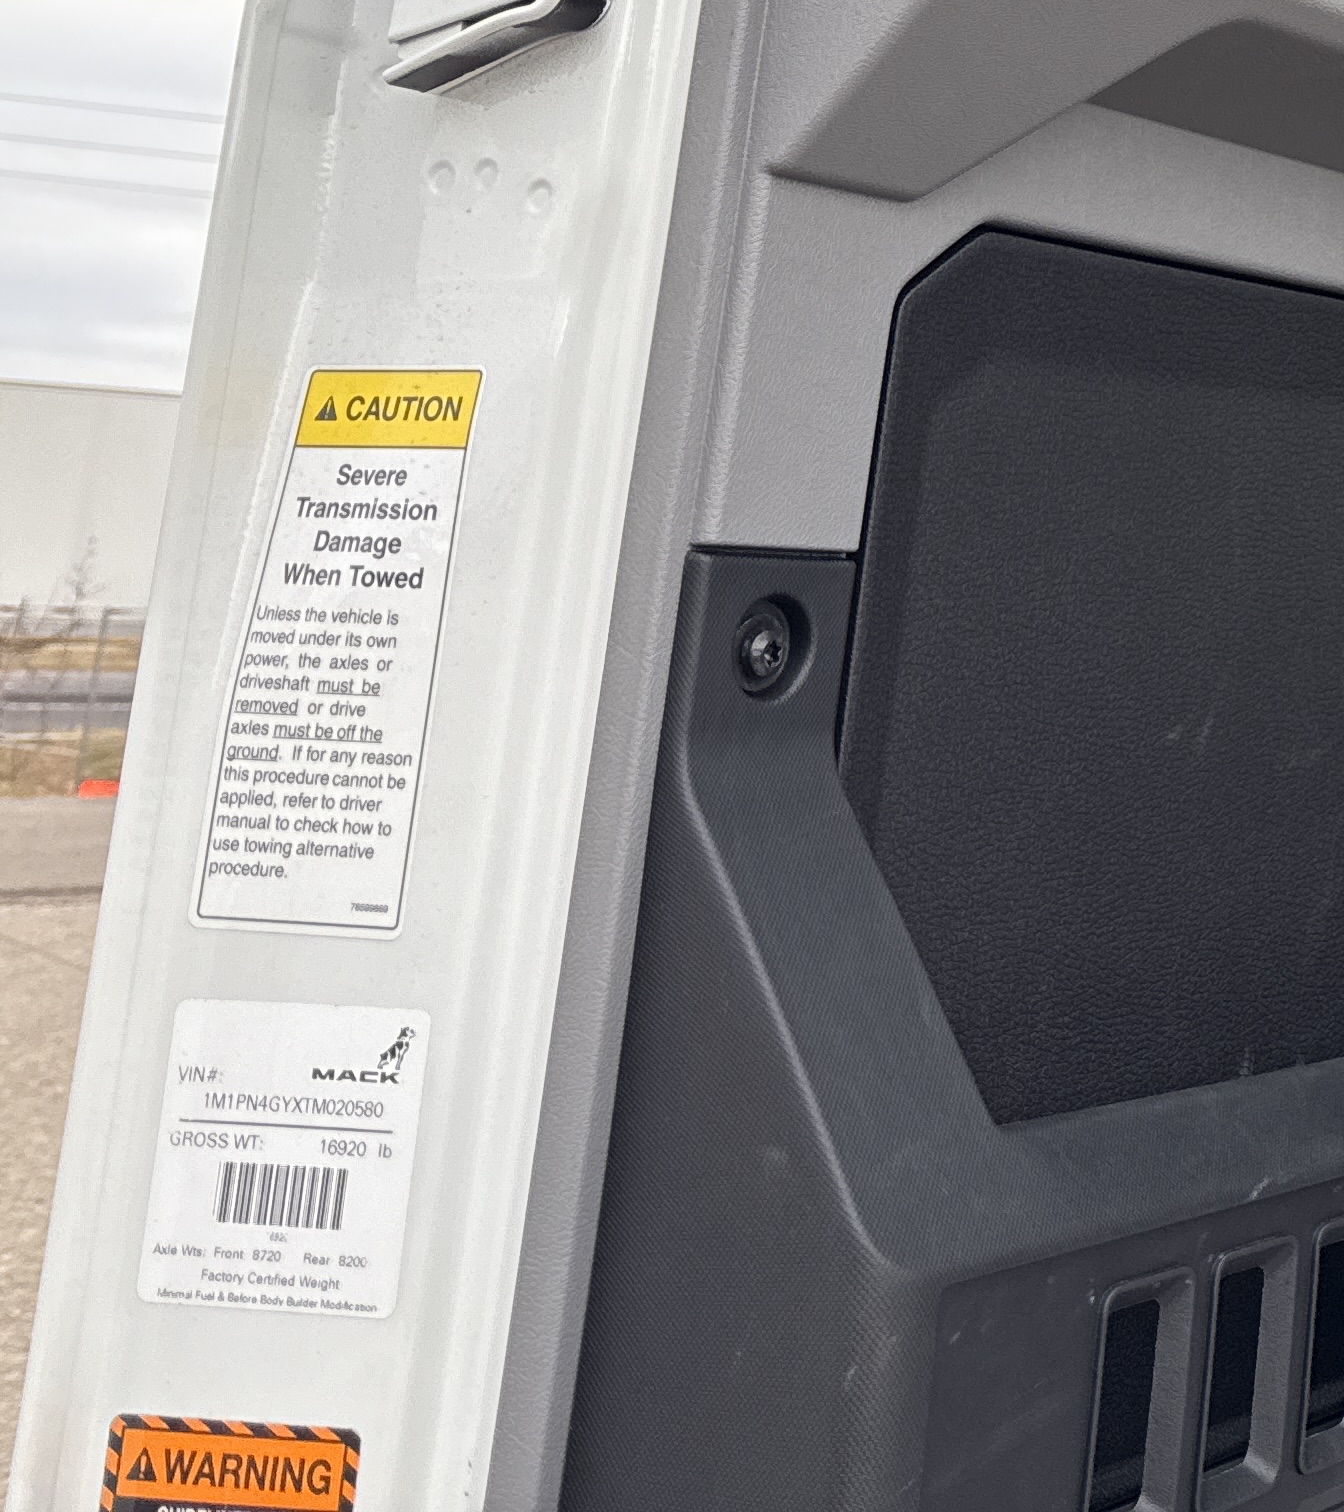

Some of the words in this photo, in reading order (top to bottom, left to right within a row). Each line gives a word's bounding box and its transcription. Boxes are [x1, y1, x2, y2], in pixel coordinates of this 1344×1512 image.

[345, 395, 464, 422] CAUTION
[336, 463, 408, 487] Severe
[296, 496, 438, 521] Transmission
[312, 529, 402, 560] Damage
[284, 562, 342, 586] When
[351, 564, 425, 590] Towed
[256, 606, 302, 623] Unless
[304, 606, 327, 623] the
[331, 607, 383, 625] vehicle
[386, 609, 399, 626] is
[250, 629, 296, 645] moved
[298, 630, 342, 647] under
[344, 631, 363, 649] its
[366, 635, 398, 649] own
[243, 653, 289, 669] power,
[298, 652, 322, 669] the
[328, 654, 369, 671] axles
[376, 659, 394, 673] or
[239, 674, 311, 691] driveshaft
[316, 678, 355, 695] must
[360, 678, 381, 696] be
[234, 698, 300, 716] removed
[307, 702, 324, 715] or
[329, 700, 366, 718] drive
[230, 719, 270, 737] axles
[272, 722, 312, 739] must
[312, 722, 334, 740] be
[336, 724, 358, 741] off
[359, 725, 384, 742] the
[291, 745, 303, 761] If
[306, 745, 327, 762] for
[329, 750, 358, 768] any
[360, 752, 413, 767] reason
[223, 765, 250, 782] this
[252, 768, 330, 787] procedure
[331, 773, 384, 789] cannot
[386, 773, 407, 790] be
[219, 789, 277, 809] applied,
[282, 791, 319, 809] refer
[320, 793, 336, 810] to
[339, 794, 383, 813] driver
[216, 814, 272, 830] manual
[275, 815, 290, 832] to
[293, 815, 339, 834] check
[342, 817, 374, 836] how
[377, 820, 393, 837] to
[212, 838, 240, 852] use
[243, 836, 293, 859] towing
[295, 839, 375, 860] alternative
[207, 861, 288, 878] procedure.
[311, 1067, 401, 1085] MACK
[204, 1092, 384, 1119] 1M1PN4GYXTM020580
[169, 1130, 229, 1149] GROSS
[320, 1138, 367, 1158] 16920
[378, 1143, 393, 1159] lb
[152, 1242, 178, 1256] Axle
[213, 1246, 245, 1260] Front
[251, 1248, 282, 1263] 8720
[303, 1252, 331, 1266] Rear
[338, 1255, 369, 1269] 8200
[200, 1268, 244, 1286] Factory
[247, 1271, 296, 1287] Certified
[299, 1275, 340, 1292] Weight
[194, 1289, 216, 1302] Fuel
[217, 1291, 225, 1302] &
[259, 1294, 285, 1307] Body
[164, 1447, 332, 1496] WARNING
